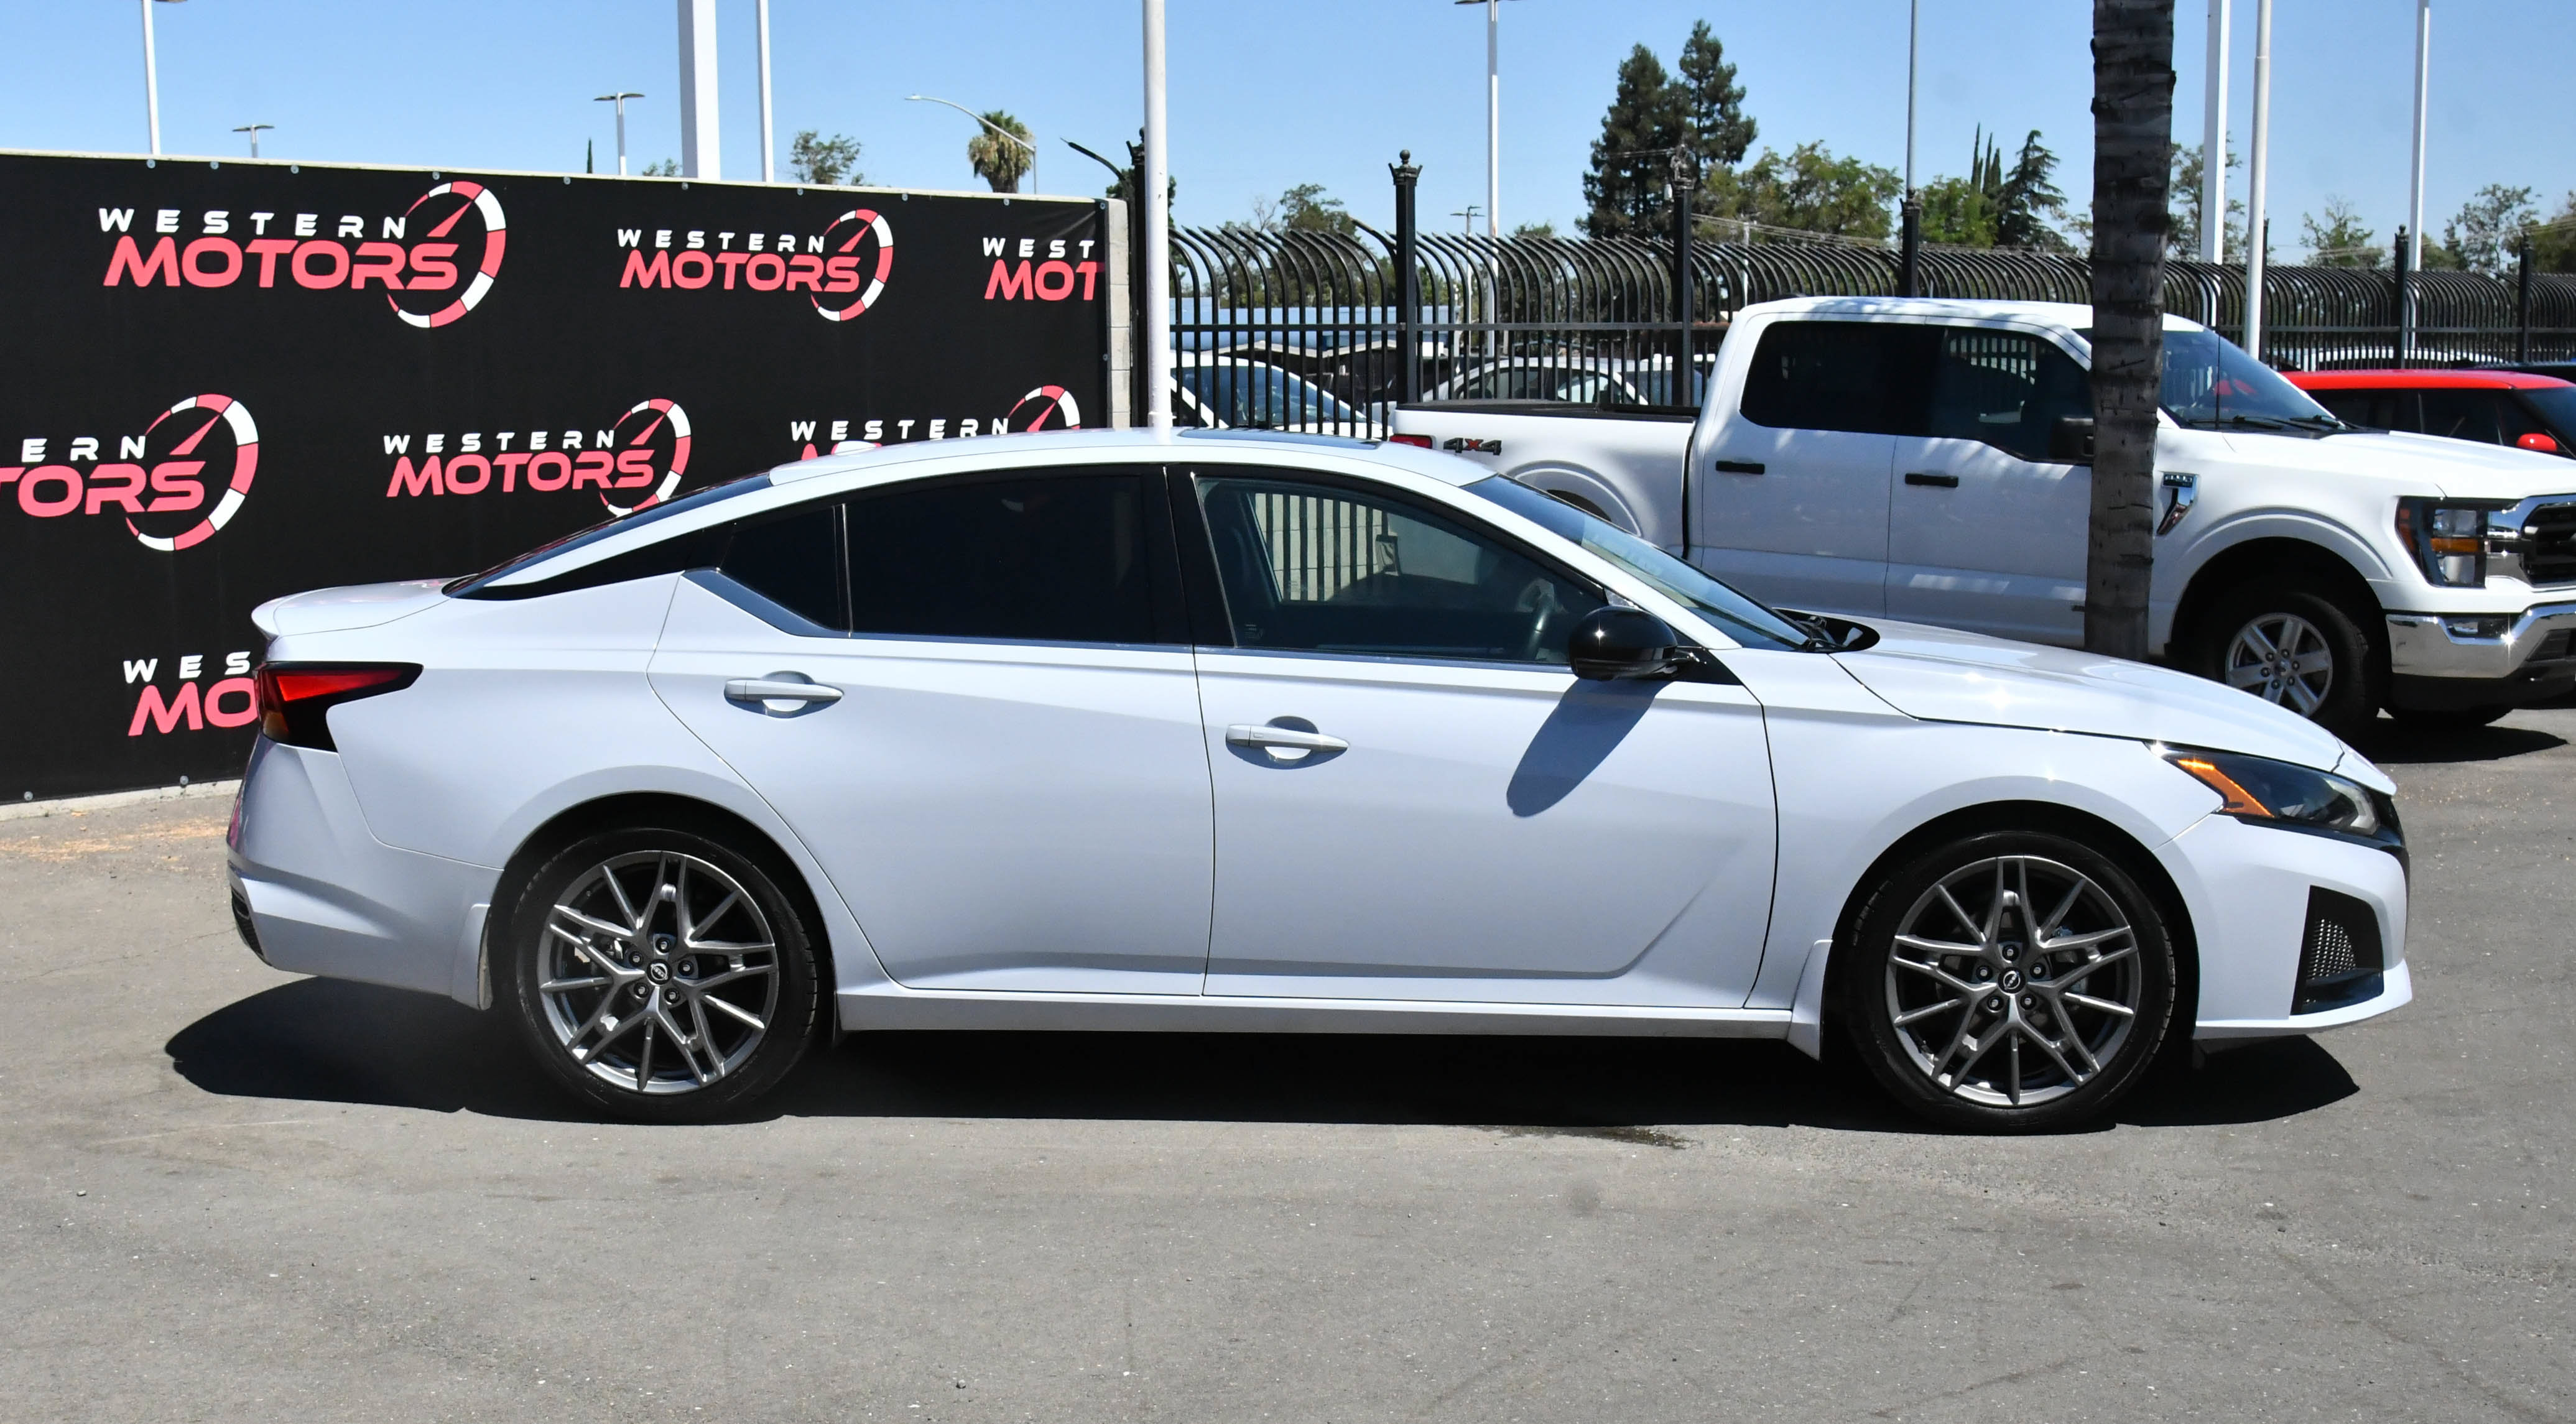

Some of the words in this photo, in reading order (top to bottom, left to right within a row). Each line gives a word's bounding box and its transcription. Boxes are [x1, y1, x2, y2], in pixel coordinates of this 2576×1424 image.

[99, 208, 406, 239] WESTERN
[618, 229, 825, 254] WESTERN
[983, 237, 1095, 259] WEST
[103, 235, 458, 290] MOTORS
[619, 249, 861, 293] MOTORS
[985, 259, 1098, 301] MOT
[383, 430, 614, 455] WESTERN
[790, 417, 1009, 442] WESTERN
[386, 449, 655, 497] MOTORS
[123, 651, 251, 684] WES
[128, 677, 259, 736] MO
